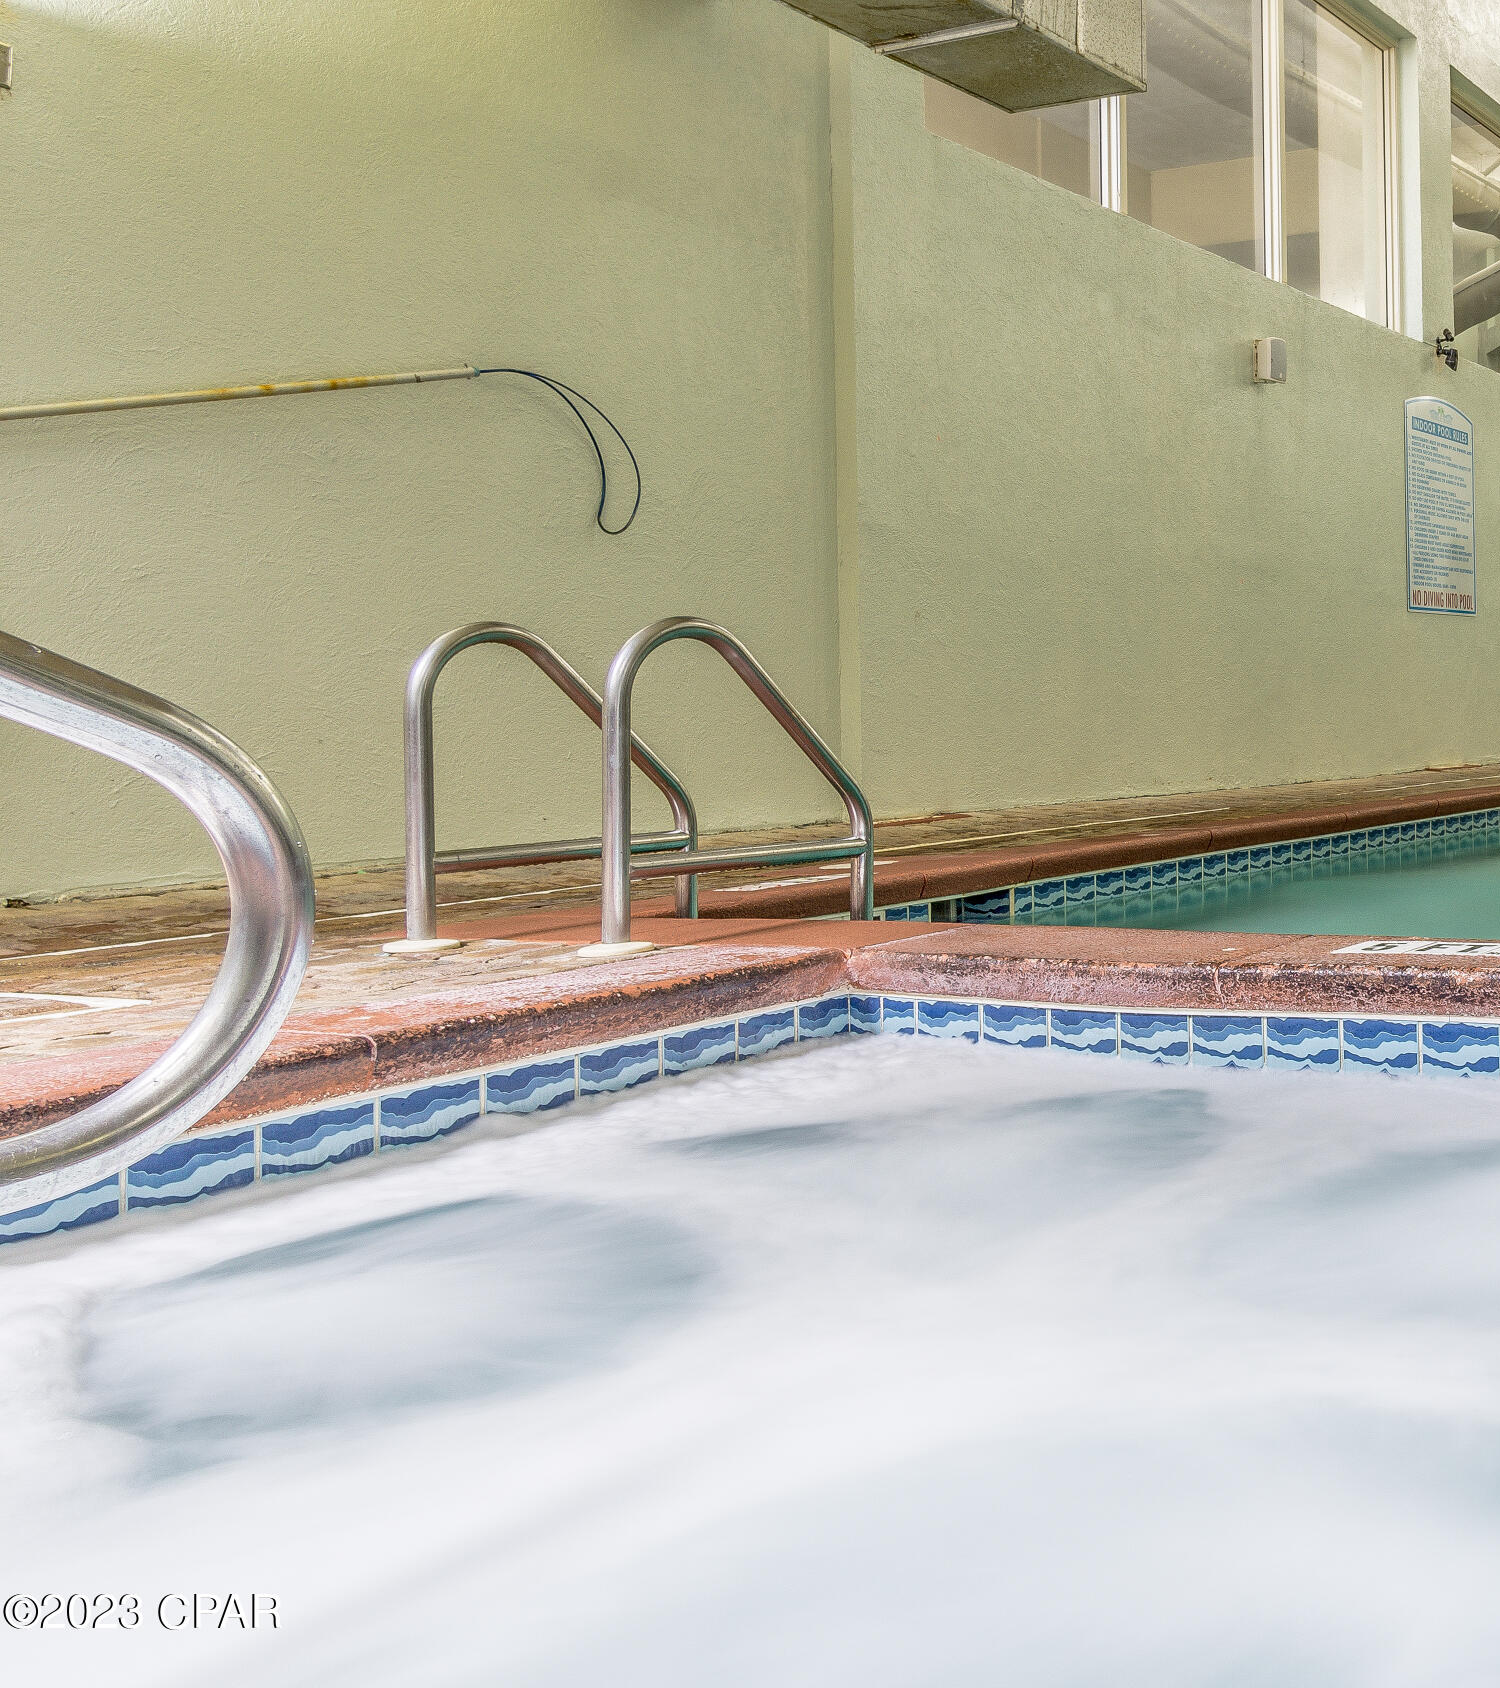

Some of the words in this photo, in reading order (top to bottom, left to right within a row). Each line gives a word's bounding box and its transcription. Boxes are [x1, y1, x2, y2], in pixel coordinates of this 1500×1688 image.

[1413, 418, 1436, 434] INDOOR
[1437, 425, 1452, 440] POOL
[1453, 430, 1468, 444] RULES
[1412, 589, 1421, 606] NO
[1423, 590, 1445, 608] DIVING
[1445, 592, 1458, 609] INTO
[1459, 594, 1474, 610] POOL
[1415, 943, 1498, 953] FT
